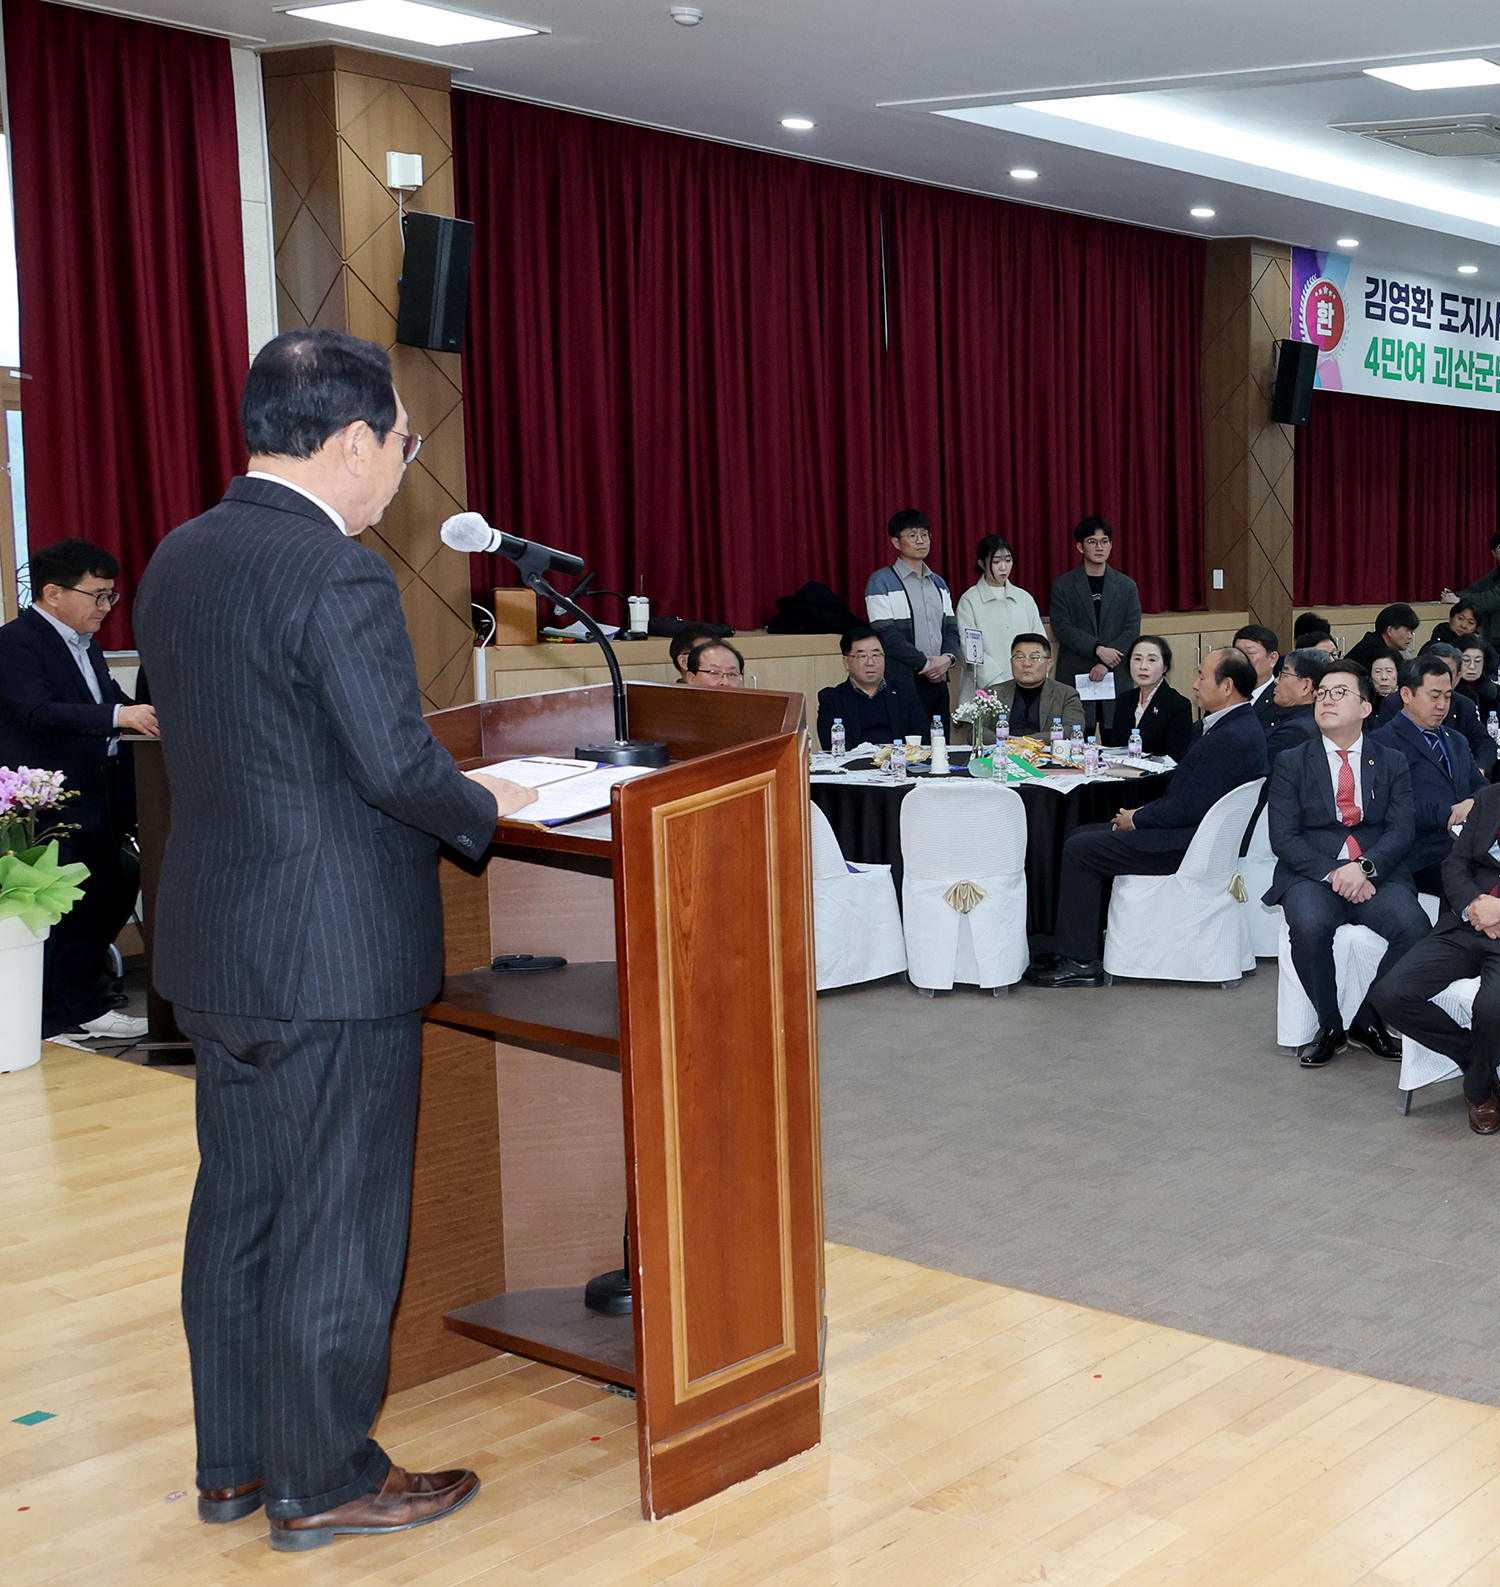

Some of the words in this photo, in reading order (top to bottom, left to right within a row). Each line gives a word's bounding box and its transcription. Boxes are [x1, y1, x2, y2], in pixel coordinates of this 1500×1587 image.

[1316, 301, 1334, 336] 환
[1364, 276, 1434, 329] 김영환
[1364, 336, 1425, 384] 4만여
[973, 644, 977, 658] 3
